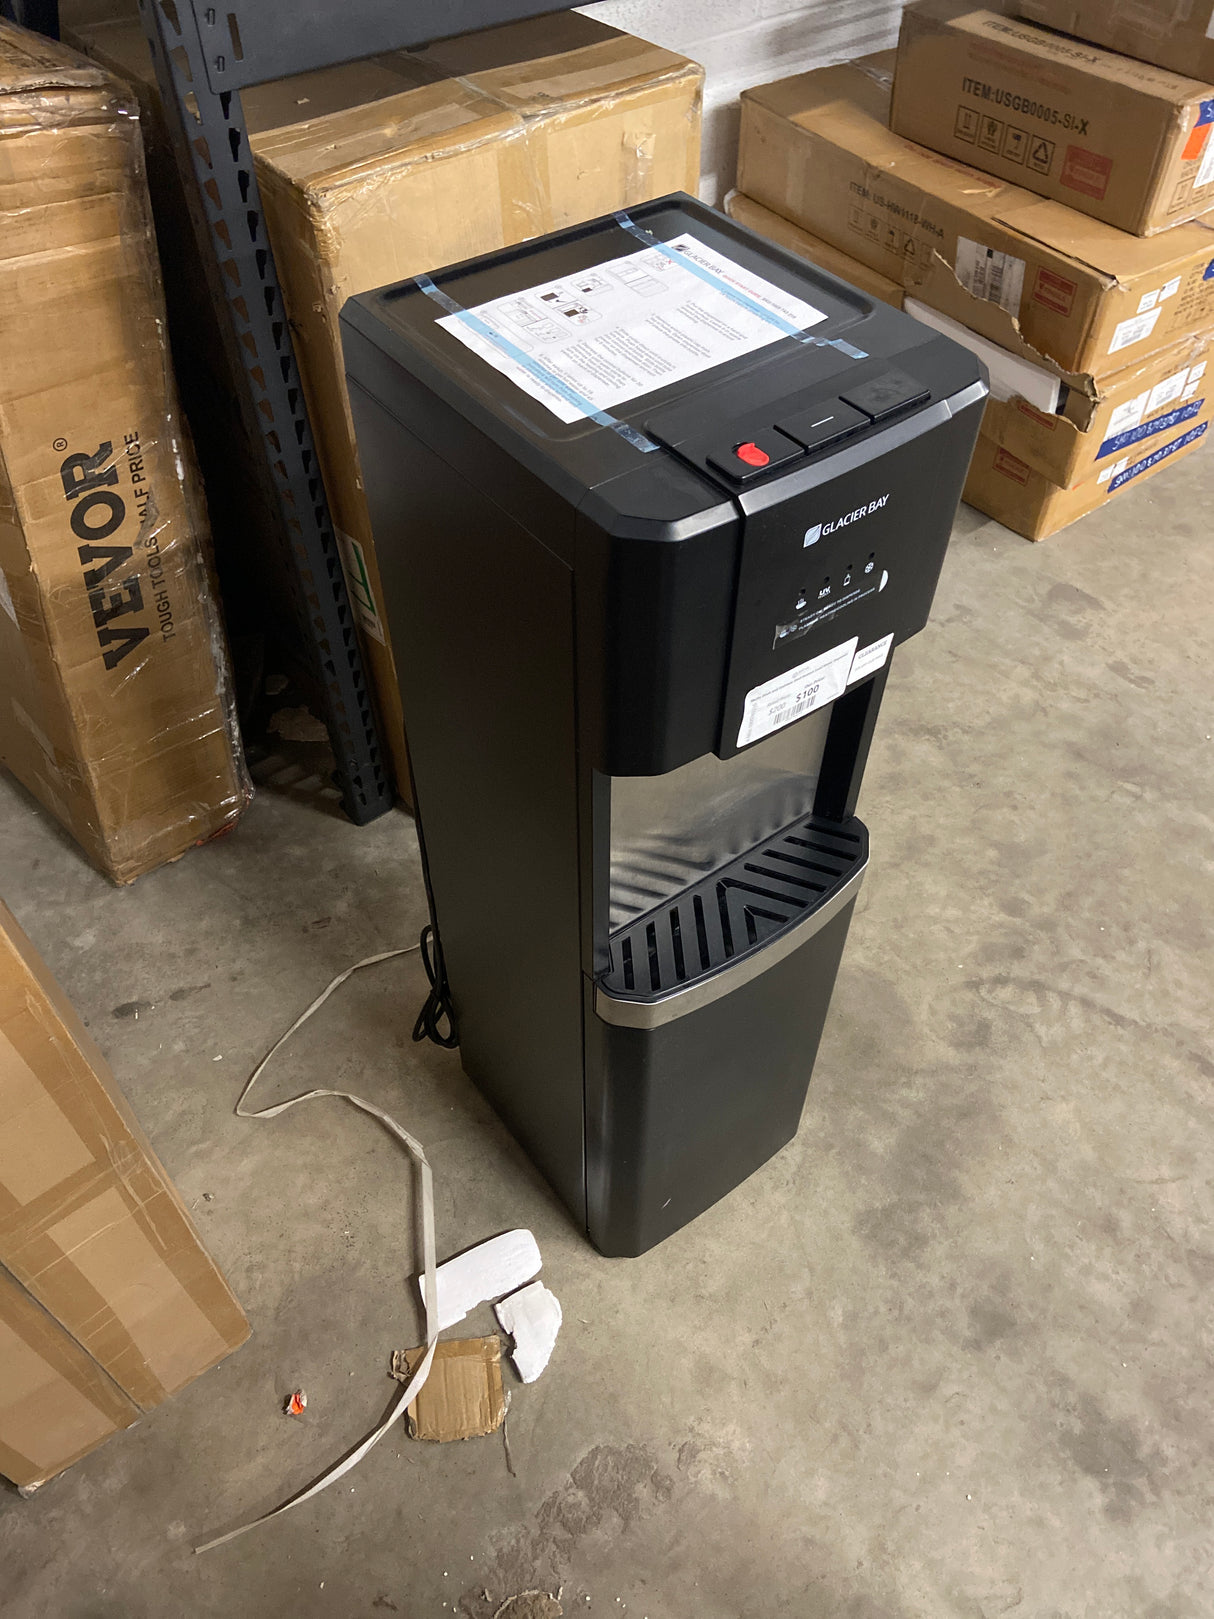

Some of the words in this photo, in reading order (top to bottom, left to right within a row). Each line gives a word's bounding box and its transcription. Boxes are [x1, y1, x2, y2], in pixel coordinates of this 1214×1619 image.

[683, 249, 711, 271] GLACIER
[708, 264, 724, 276] BAY
[123, 431, 146, 484] PRICE
[822, 506, 867, 536] GLACIER
[867, 493, 890, 514] BAY
[60, 440, 150, 671] VEVOR
[155, 588, 176, 643] TOUGH
[795, 684, 820, 703] $100
